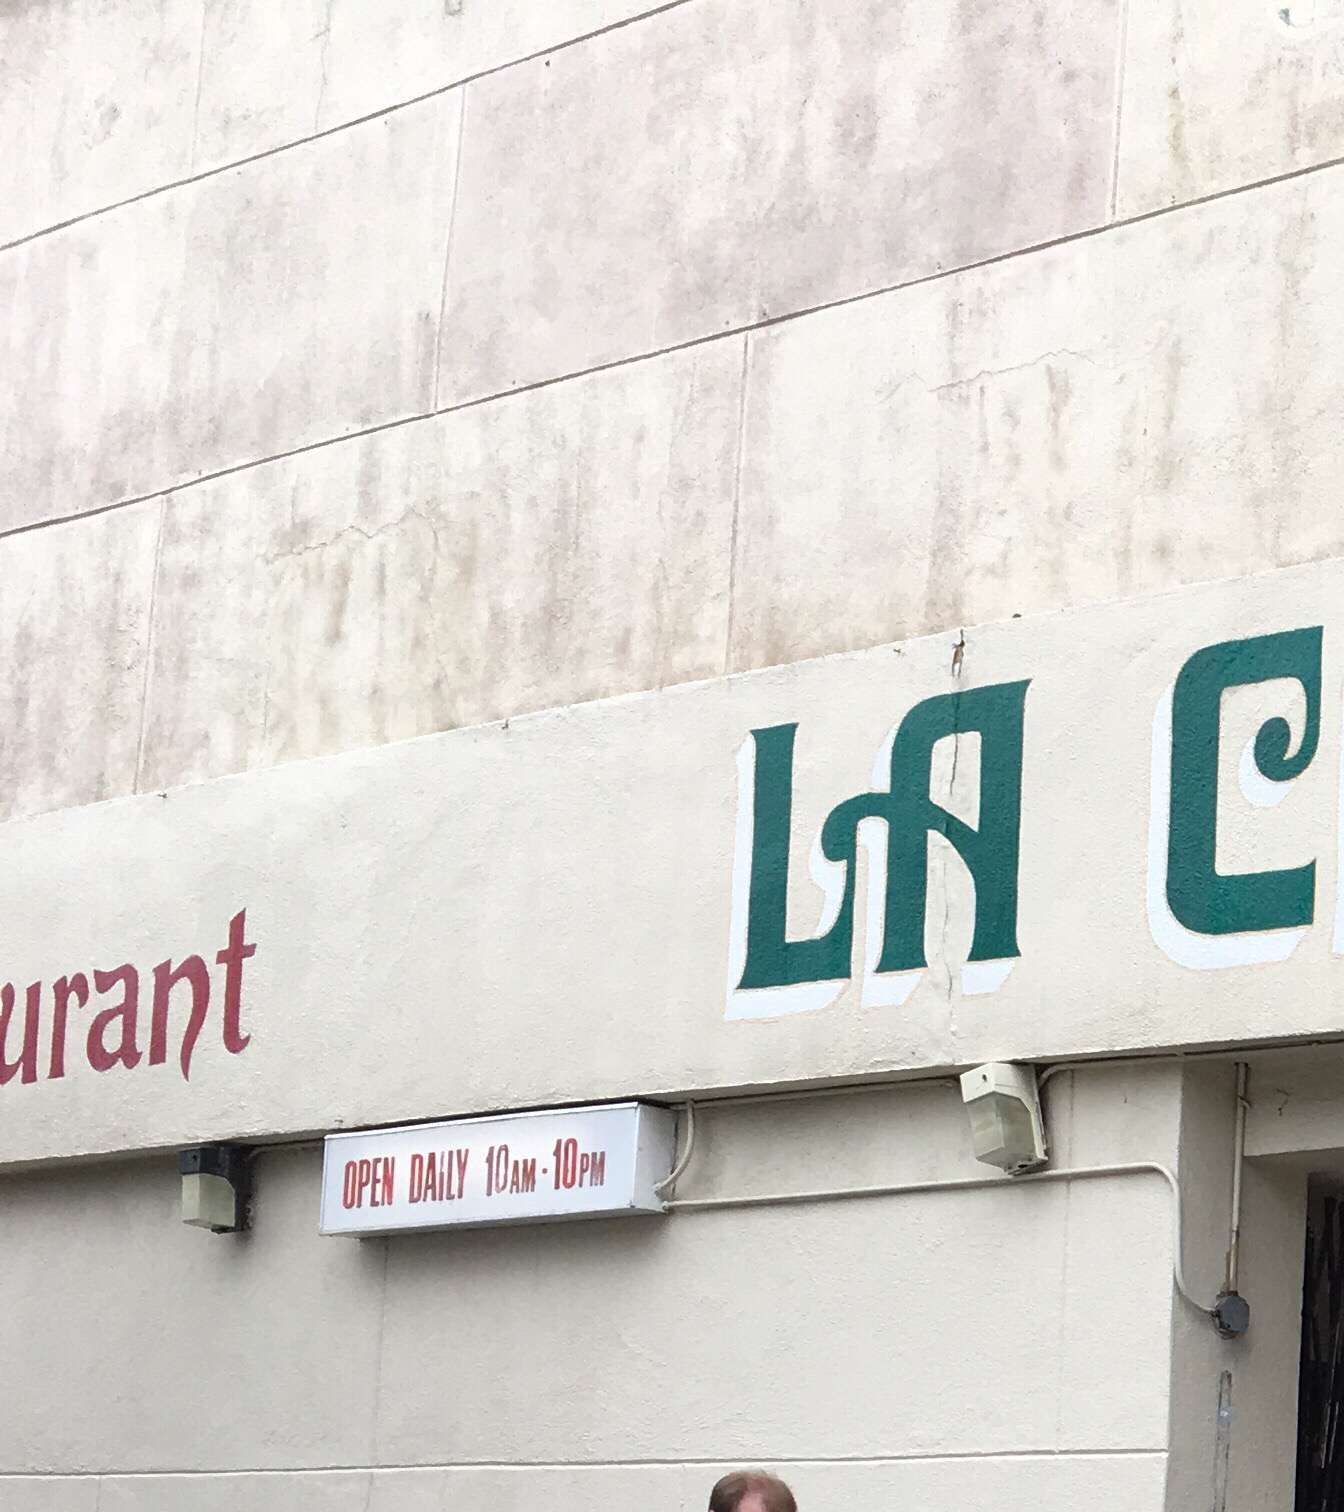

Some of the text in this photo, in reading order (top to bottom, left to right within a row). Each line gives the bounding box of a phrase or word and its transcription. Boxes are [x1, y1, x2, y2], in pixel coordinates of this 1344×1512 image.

[732, 678, 1033, 992] LA
[0, 907, 257, 1086] urant
[342, 1156, 396, 1209] OPEN
[408, 1149, 470, 1204] DAILY
